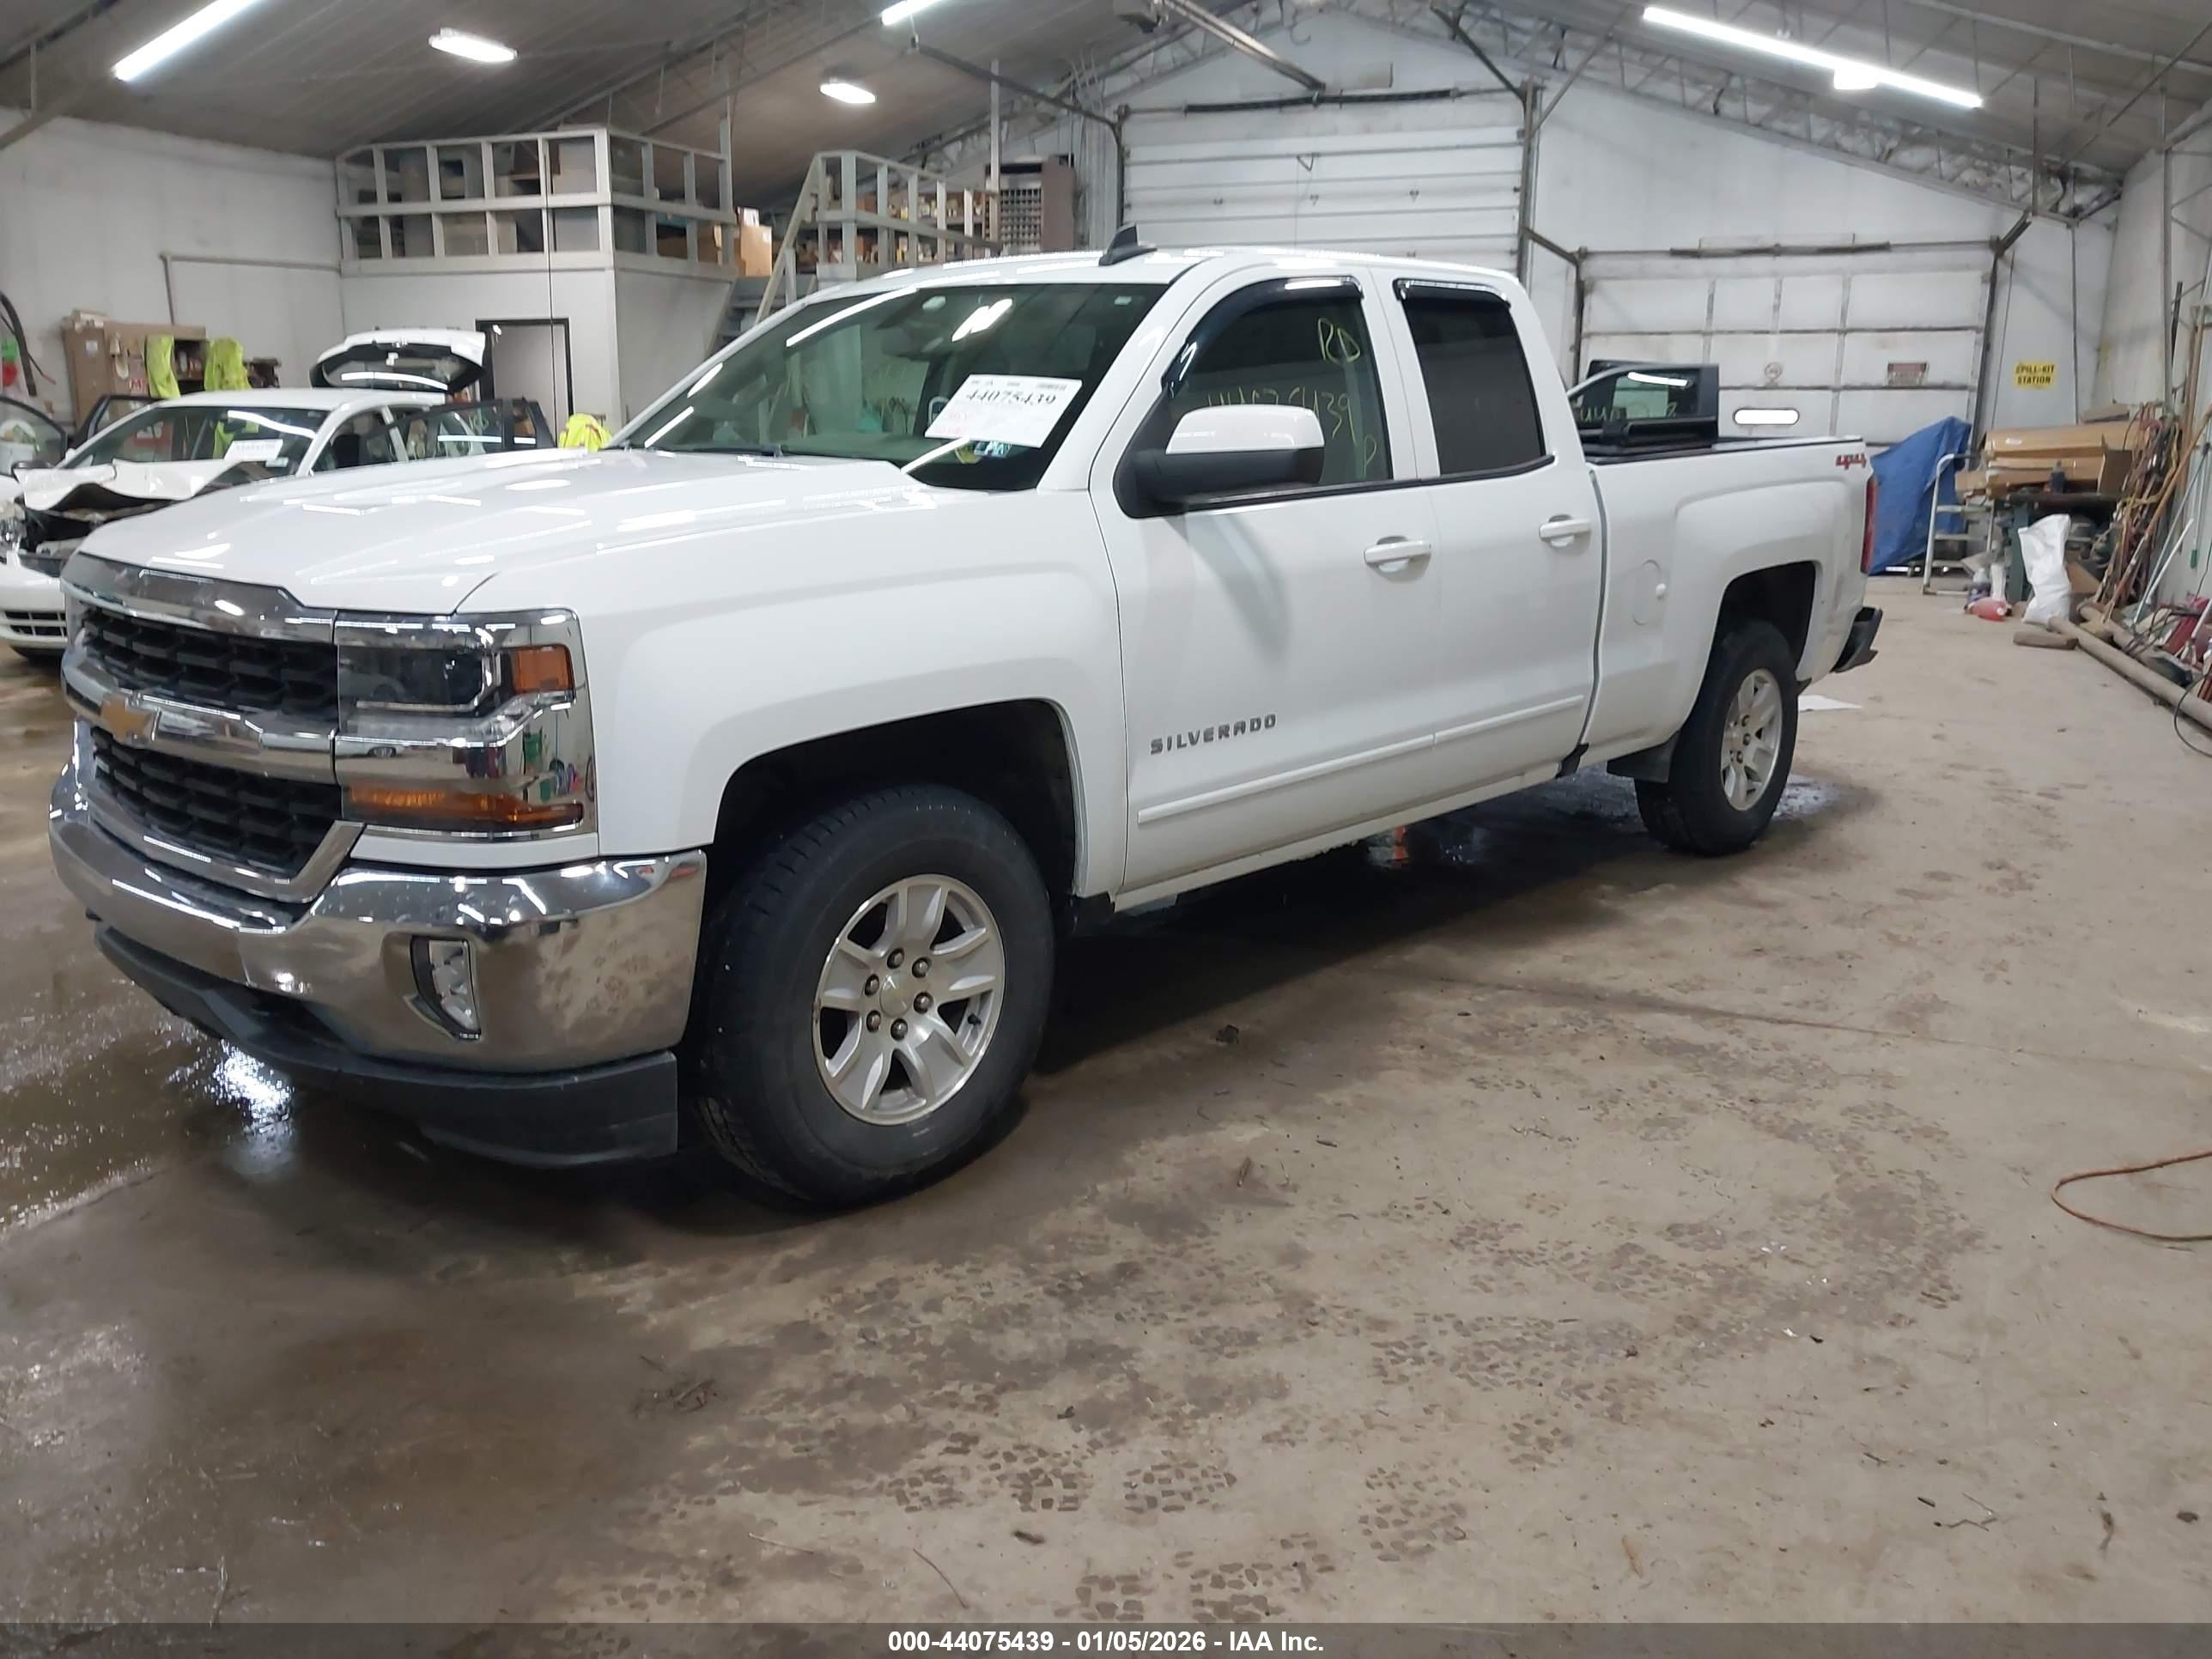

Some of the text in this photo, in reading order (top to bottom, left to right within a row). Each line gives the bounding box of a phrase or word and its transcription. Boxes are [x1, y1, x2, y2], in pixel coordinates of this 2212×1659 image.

[2017, 375, 2051, 385] STATION
[966, 389, 1057, 406] 44075439
[1150, 713, 1277, 755] SILVERADO
